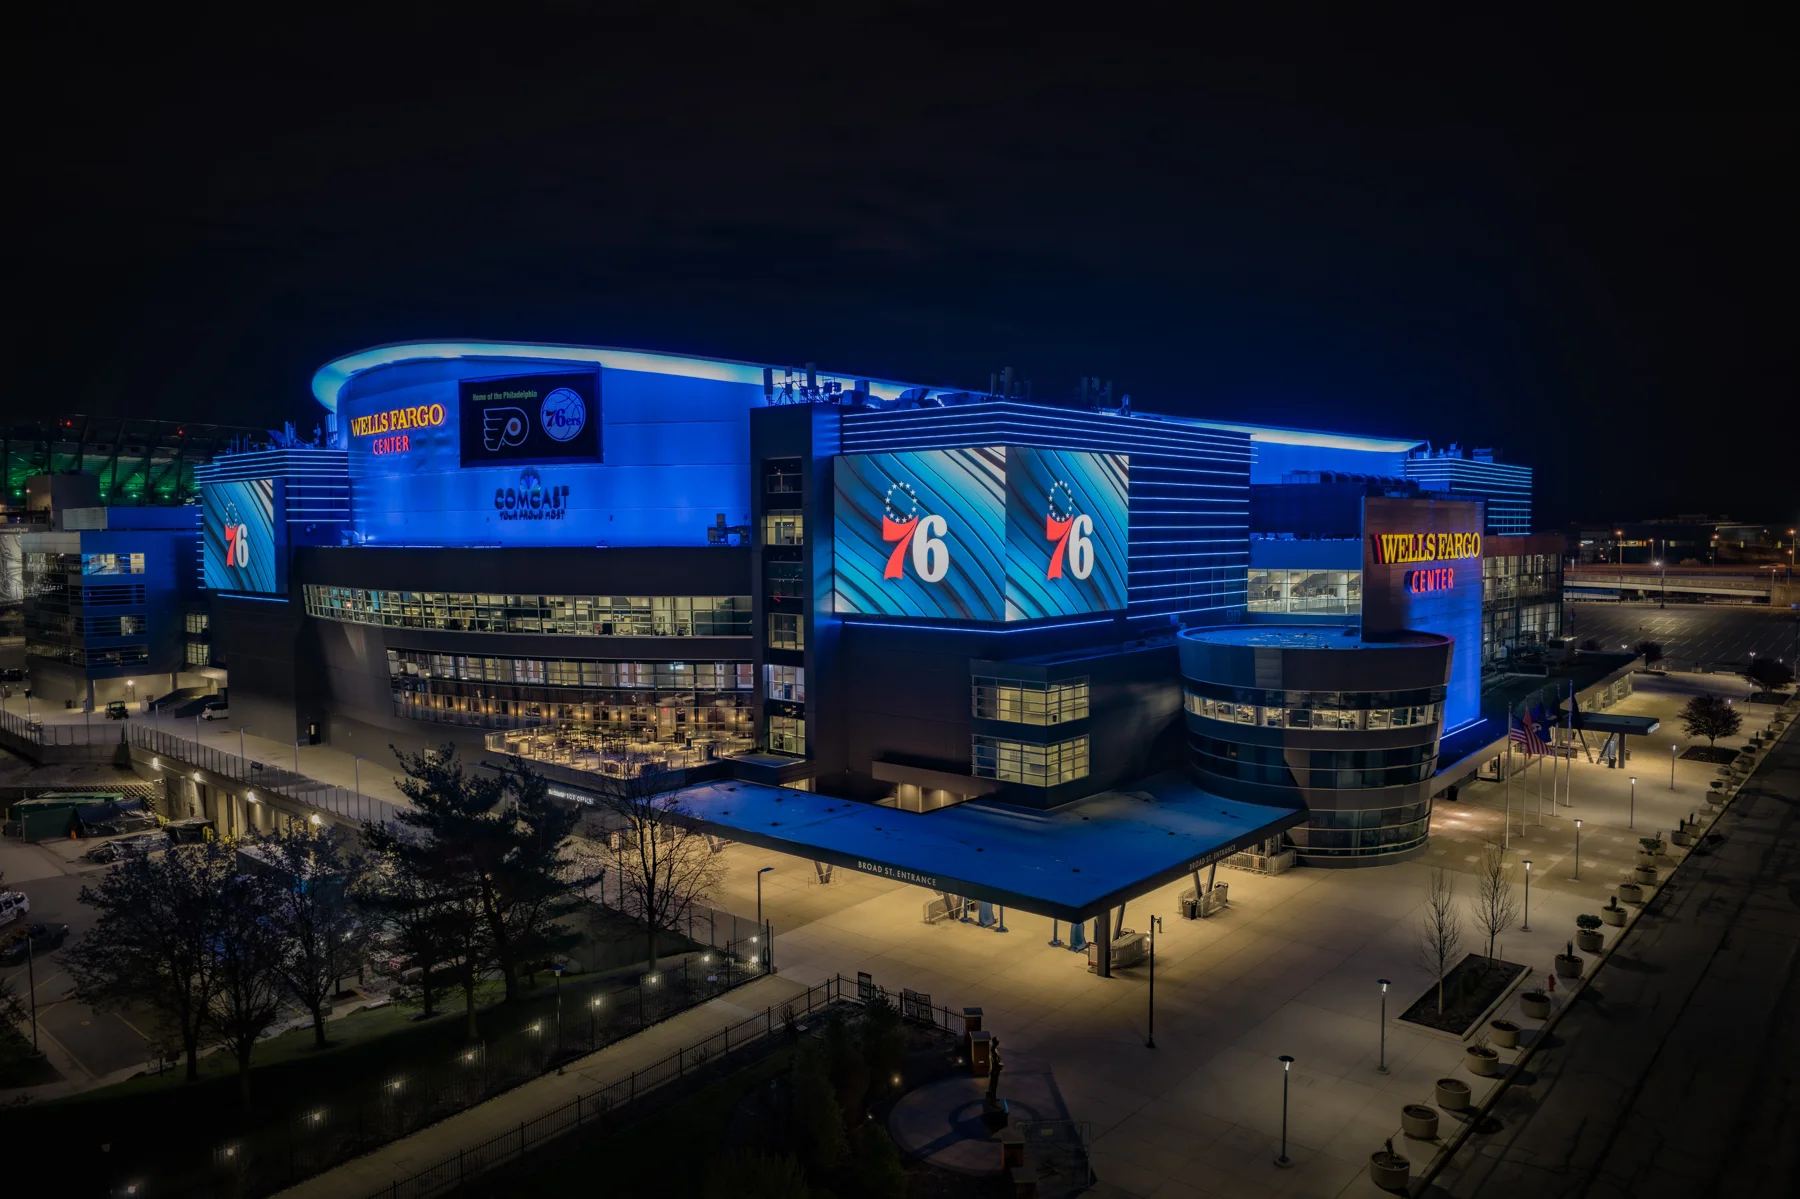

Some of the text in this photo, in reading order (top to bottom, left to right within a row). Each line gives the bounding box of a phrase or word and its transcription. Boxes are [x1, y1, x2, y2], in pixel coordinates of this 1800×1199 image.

[473, 390, 537, 401] Home of the Philadelphia
[351, 403, 443, 437] WELLS FARGO
[545, 408, 581, 428] 76ers
[373, 435, 410, 455] CENTER
[494, 486, 570, 510] COMCAST
[225, 523, 250, 568] 76
[882, 513, 950, 583] 76
[1046, 513, 1095, 581] 76
[1379, 532, 1480, 564] WELLS FARGO
[1410, 567, 1454, 594] CENTER
[857, 861, 937, 887] BROAD ST. ENTRANCE
